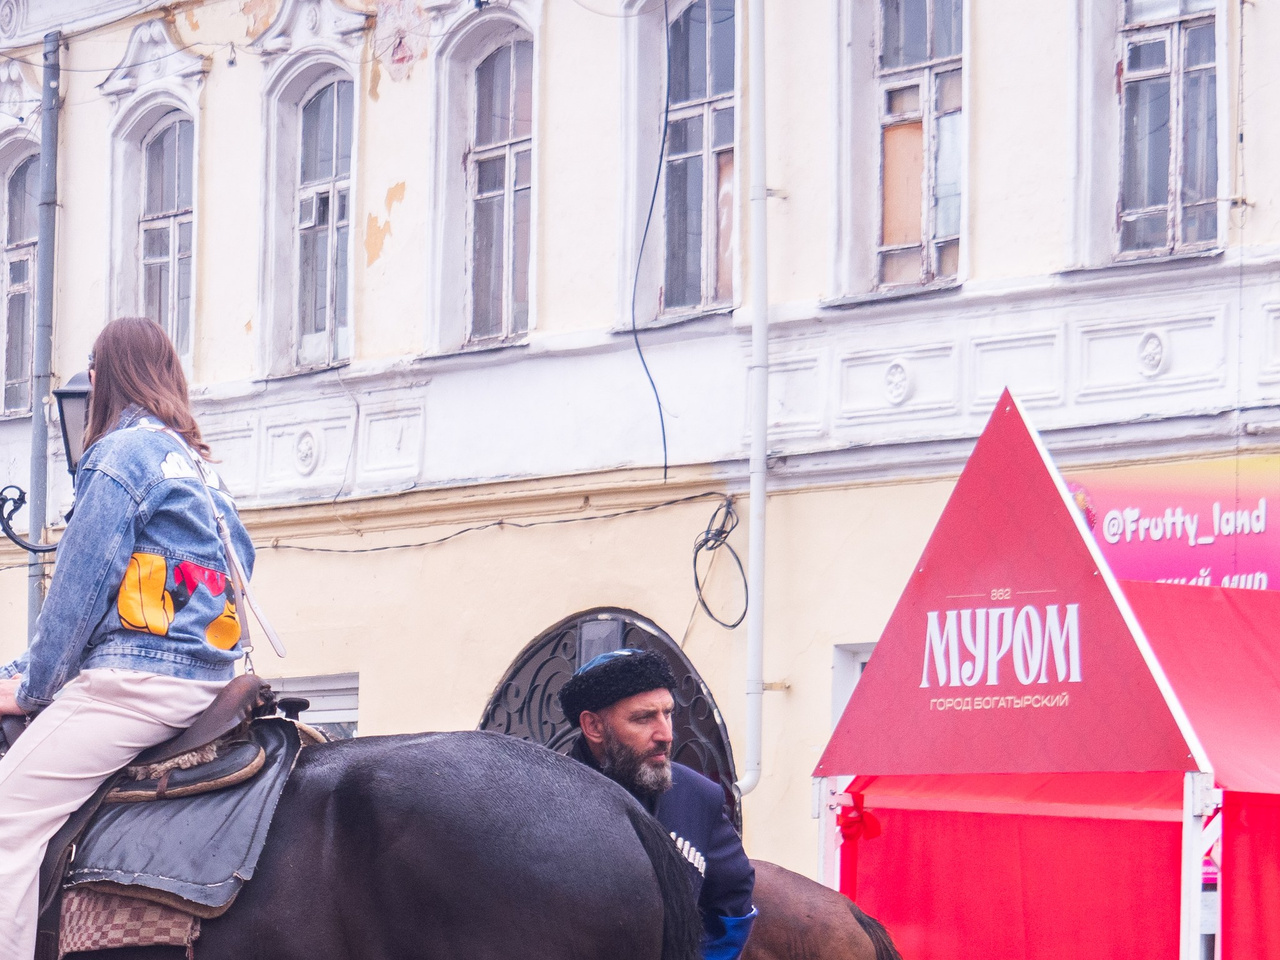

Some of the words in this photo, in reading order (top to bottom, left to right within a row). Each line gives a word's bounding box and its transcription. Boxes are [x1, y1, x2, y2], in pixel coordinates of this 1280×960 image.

[1102, 497, 1267, 546] @Frutty_land
[990, 588, 1011, 600] 862
[919, 603, 1082, 688] МУРОМ
[929, 698, 972, 711] ГОРОД
[974, 692, 1069, 710] БОГАТЫРСКИЙ
